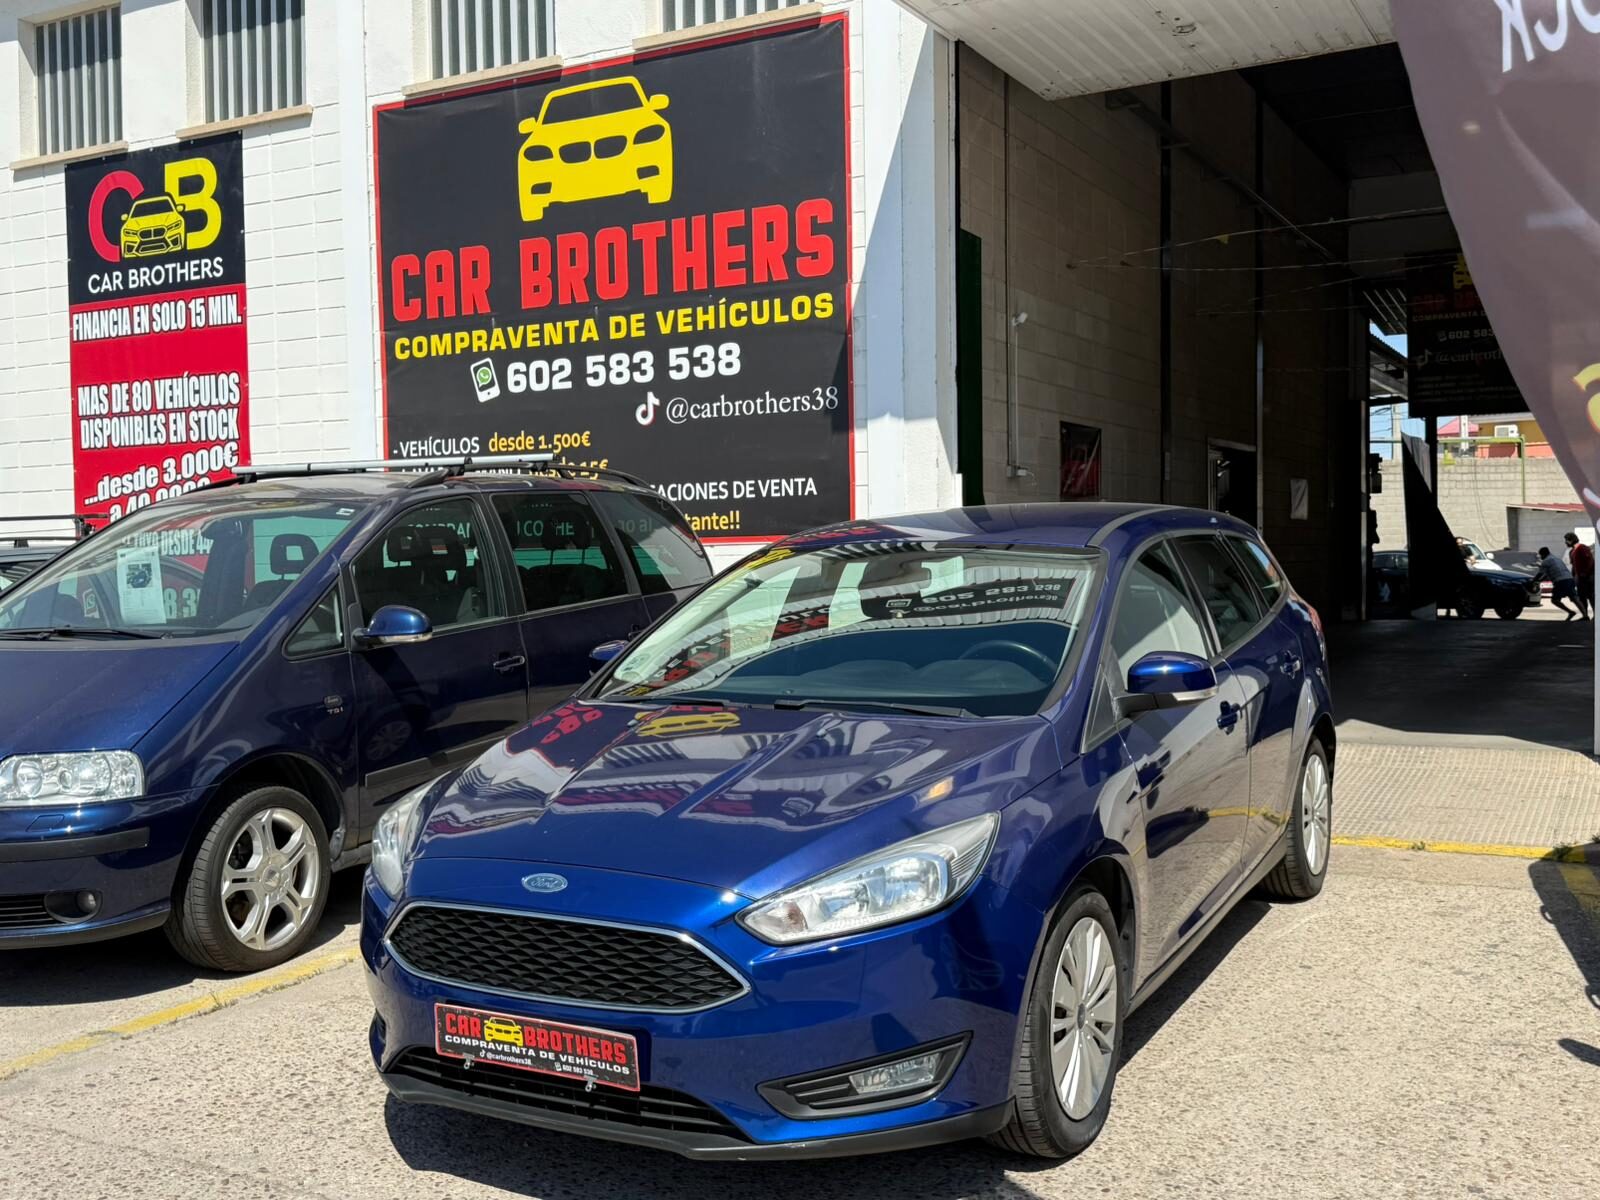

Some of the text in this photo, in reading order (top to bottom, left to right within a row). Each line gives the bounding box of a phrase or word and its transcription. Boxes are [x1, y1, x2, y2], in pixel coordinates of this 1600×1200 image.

[88, 257, 224, 294] CAR BROTHERS
[391, 198, 834, 322] CAR BROTHERS
[72, 294, 242, 342] FINANCIA EN SOLO 15 MIN.
[394, 293, 834, 360] COMPRAVENTA DE VEHÍCULOS
[507, 342, 741, 394] 602 583 538
[77, 371, 240, 417] MAS DE 80 VEHÍCULOS
[666, 386, 839, 425] @carbrothers38
[80, 408, 240, 449] DISPONIBLES EN STOCK
[488, 430, 535, 453] desde
[538, 430, 591, 454] 1.500€
[162, 441, 240, 484] 3.000€
[649, 477, 818, 502] ACIONES DE VENTA
[684, 510, 740, 532] tante!!
[160, 528, 195, 556] DESDE
[444, 1034, 630, 1075] COMPRAVENTA DE VEHÍCULOS
[445, 1012, 628, 1065] CAR BROTHERS
